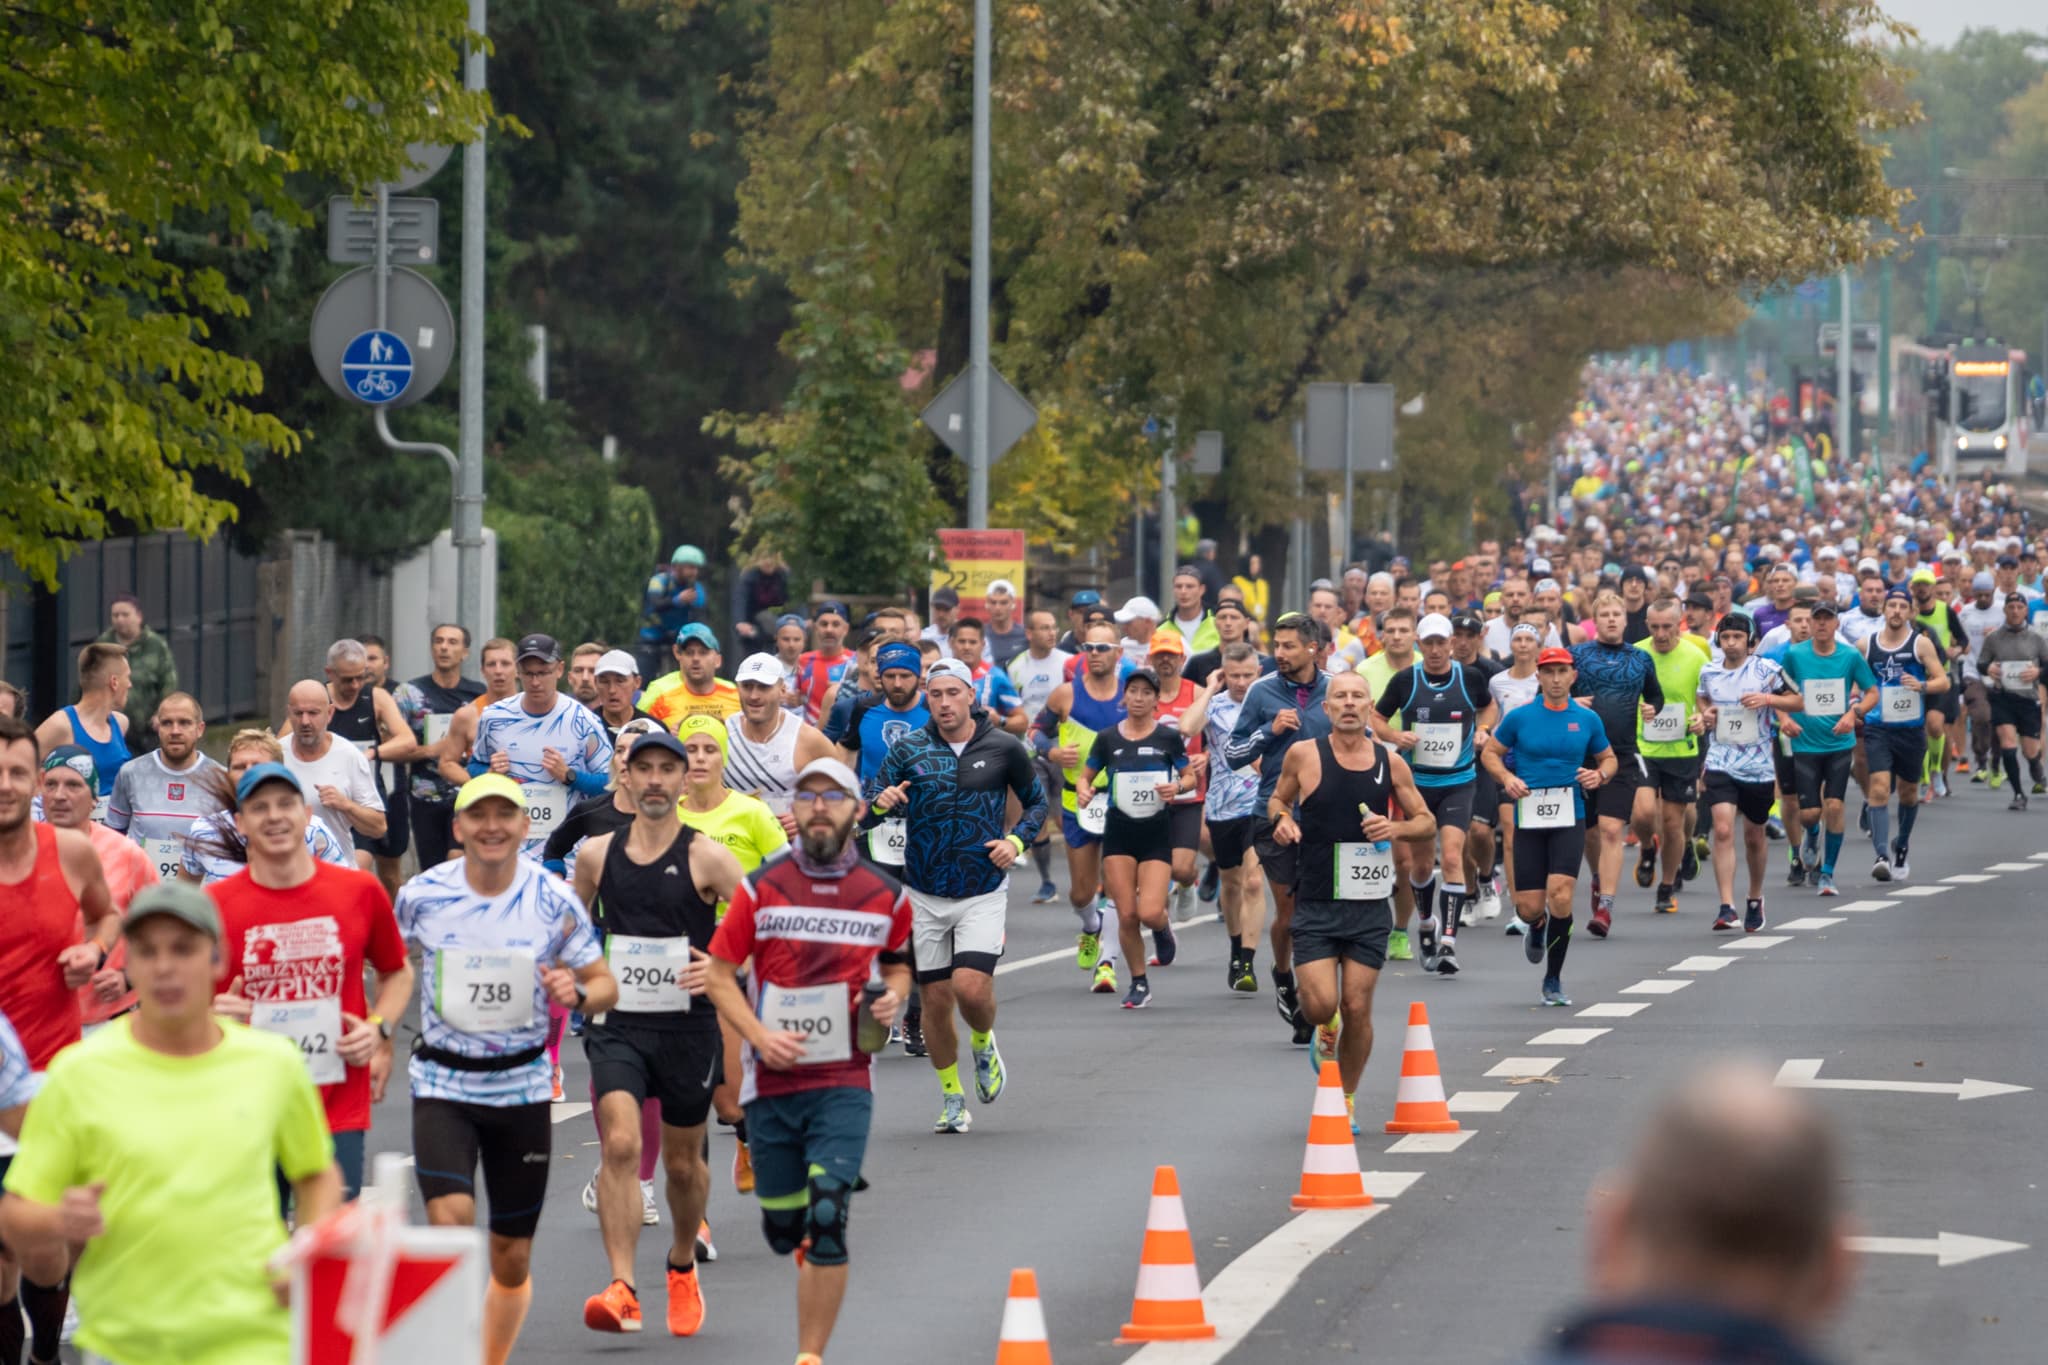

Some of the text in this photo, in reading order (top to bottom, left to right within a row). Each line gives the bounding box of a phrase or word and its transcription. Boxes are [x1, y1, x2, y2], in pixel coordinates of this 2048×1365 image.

[943, 571, 968, 591] 22
[1815, 693, 1835, 703] 953
[1893, 699, 1911, 710] 622
[1652, 718, 1678, 729] 3901
[1728, 720, 1742, 731] 79
[1423, 740, 1455, 752] 2249
[1132, 790, 1155, 802] 291
[1536, 803, 1561, 817] 837
[1355, 847, 1368, 857] 22
[1351, 864, 1390, 880] 3260
[621, 966, 677, 987] 2904
[244, 974, 344, 1002] SZPIKU
[467, 982, 512, 1004] 738
